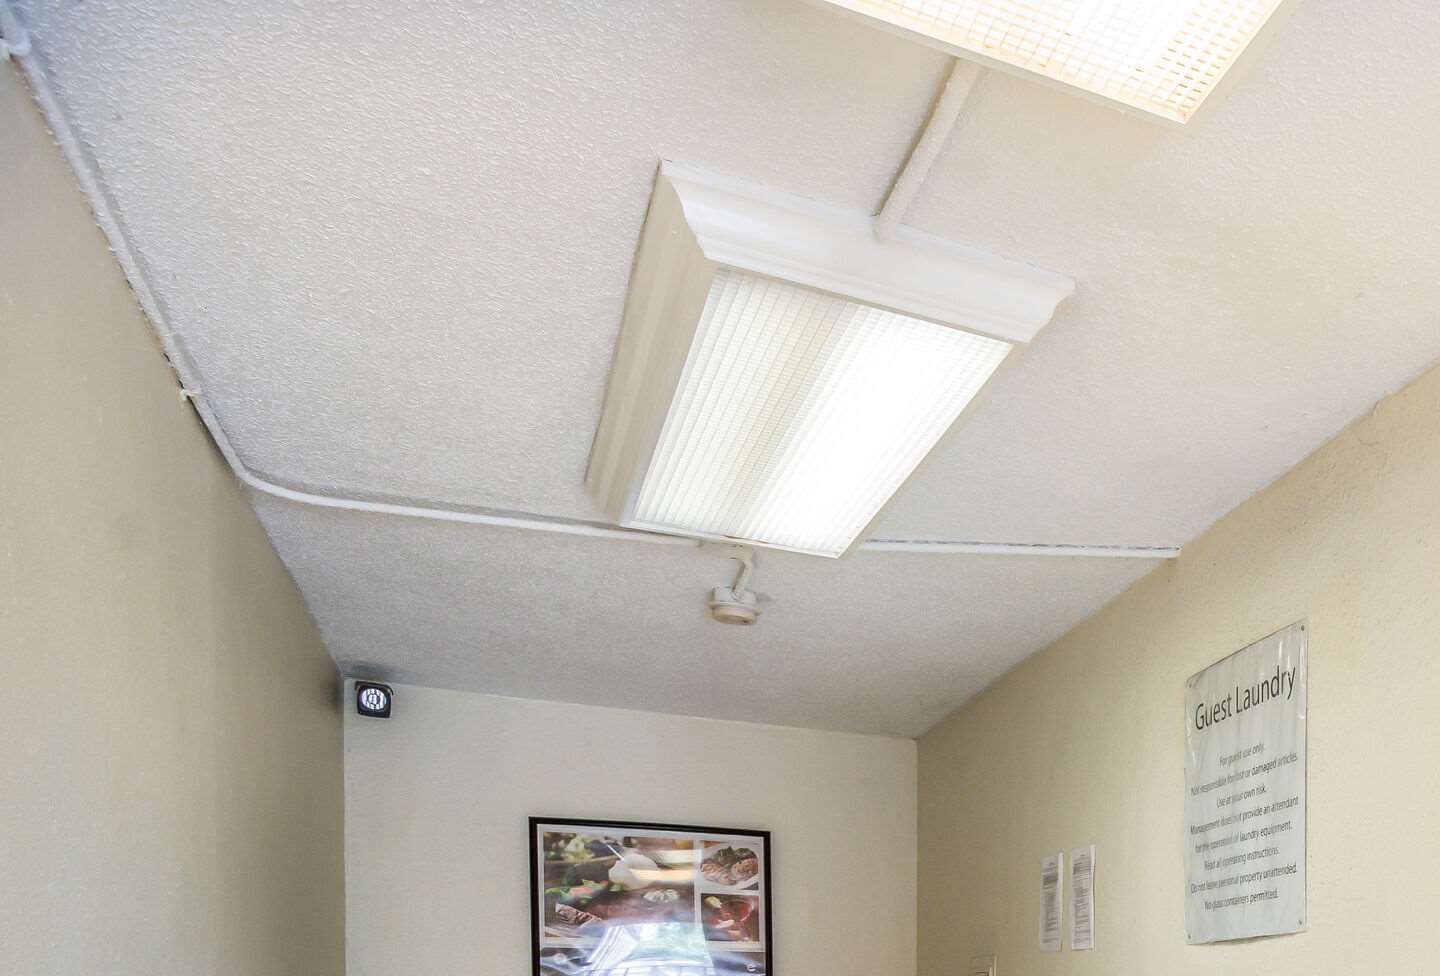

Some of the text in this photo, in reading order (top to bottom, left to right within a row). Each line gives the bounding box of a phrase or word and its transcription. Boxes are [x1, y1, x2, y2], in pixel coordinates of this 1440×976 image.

[1195, 665, 1296, 730] Guest Laundry
[1250, 757, 1276, 778] damaged
[1242, 805, 1262, 823] provide
[1271, 794, 1299, 813] attendant
[1239, 826, 1259, 843] laundry
[1239, 869, 1262, 886] property
